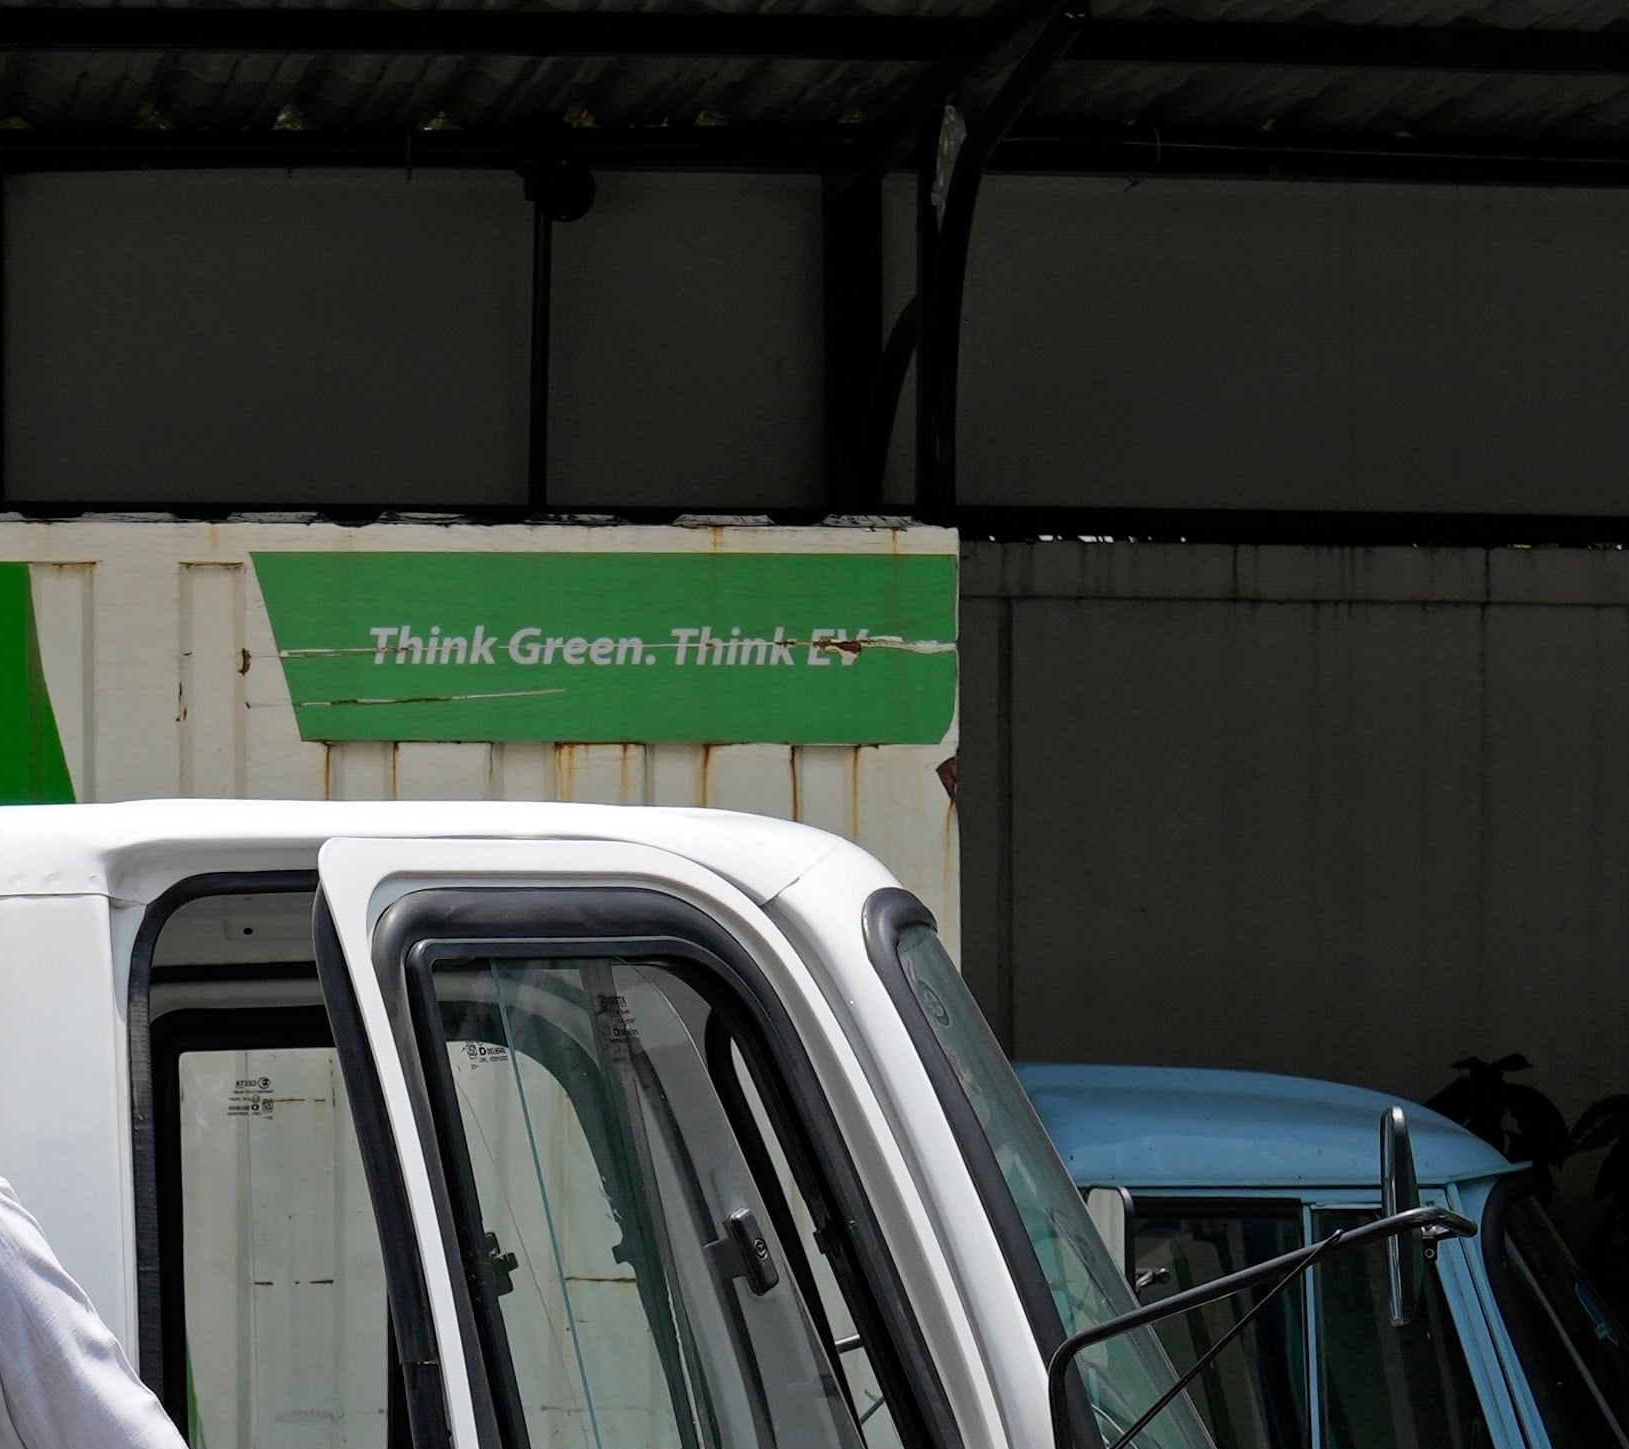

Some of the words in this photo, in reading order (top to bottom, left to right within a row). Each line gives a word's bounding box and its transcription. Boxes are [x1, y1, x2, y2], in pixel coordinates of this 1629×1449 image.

[370, 625, 498, 665] Think
[508, 626, 656, 665] Green.
[671, 626, 797, 666] Think
